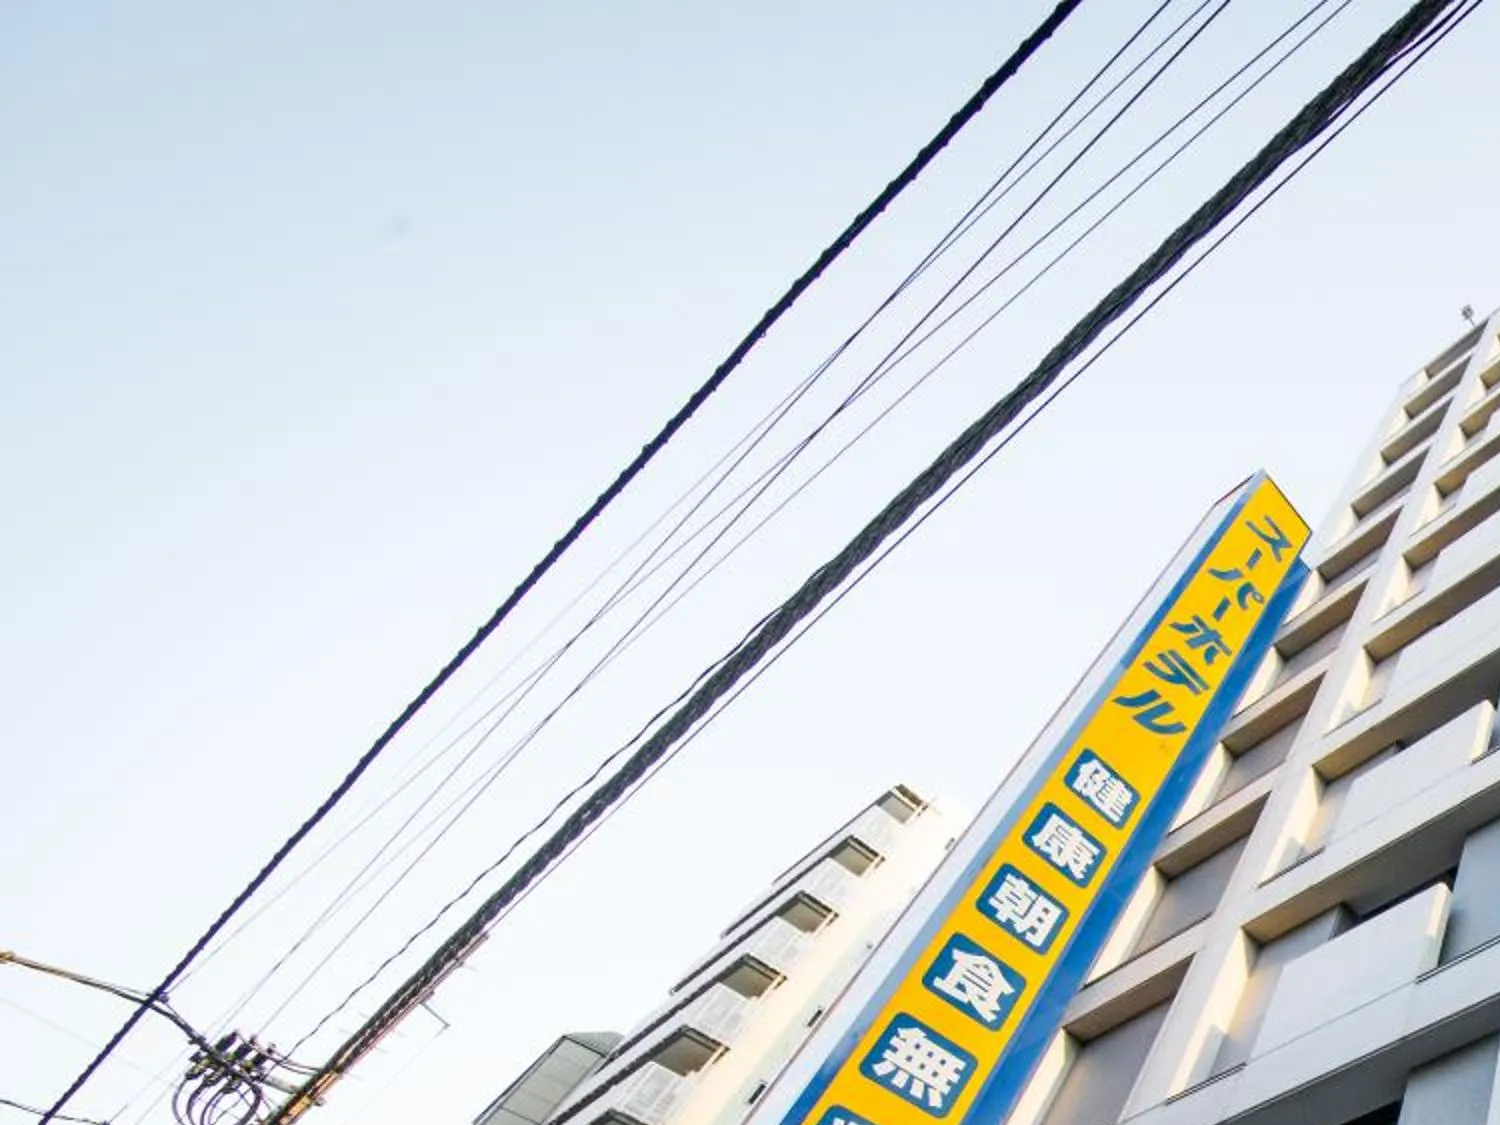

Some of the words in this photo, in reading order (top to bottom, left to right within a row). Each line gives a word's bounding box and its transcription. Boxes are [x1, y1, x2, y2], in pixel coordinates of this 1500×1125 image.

[1112, 515, 1293, 735] スーパーホテル
